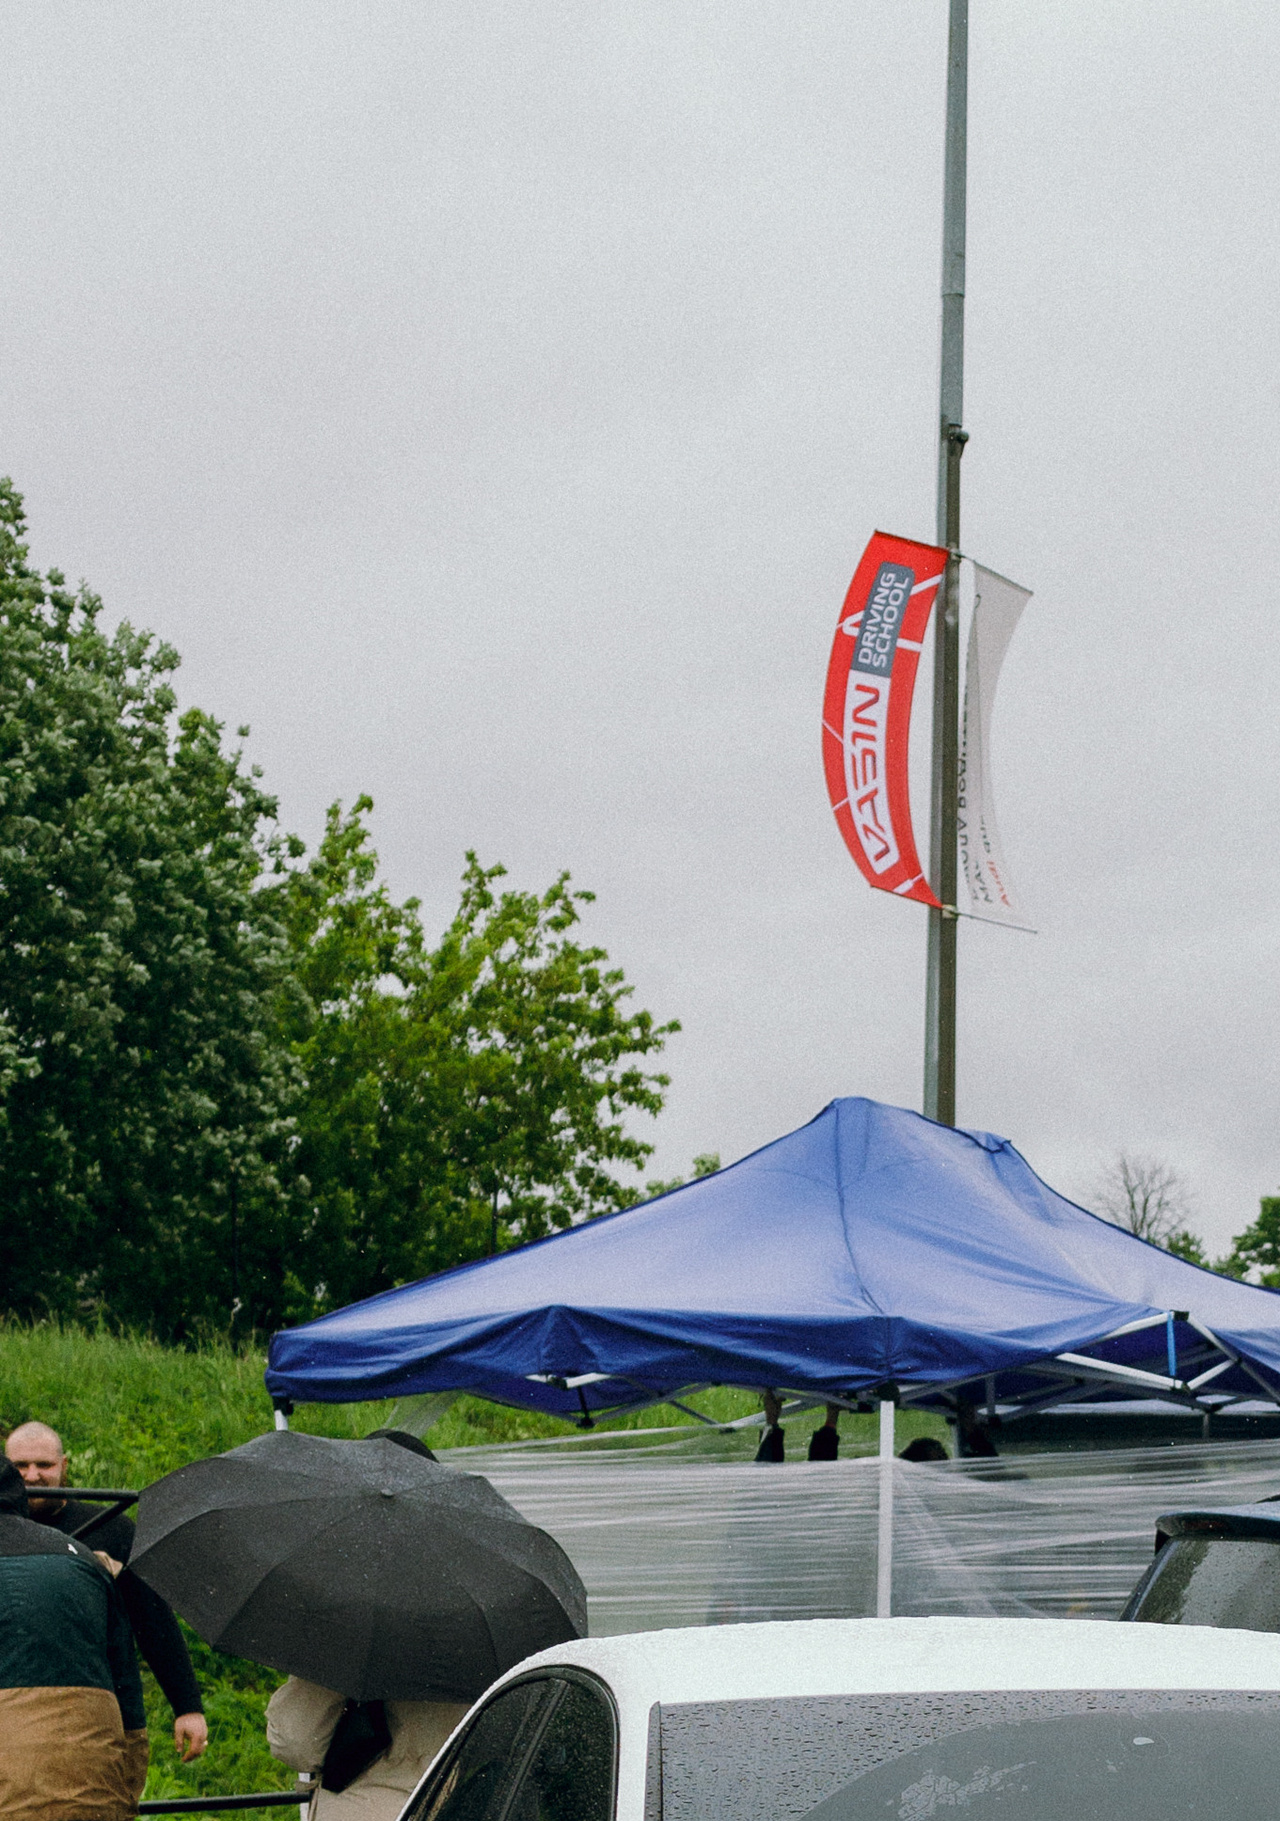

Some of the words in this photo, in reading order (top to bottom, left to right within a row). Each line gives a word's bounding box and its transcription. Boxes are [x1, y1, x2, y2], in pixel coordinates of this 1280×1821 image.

[858, 571, 895, 664] DRIVING
[872, 576, 909, 668] SCHOOL
[852, 683, 890, 862] VASIN
